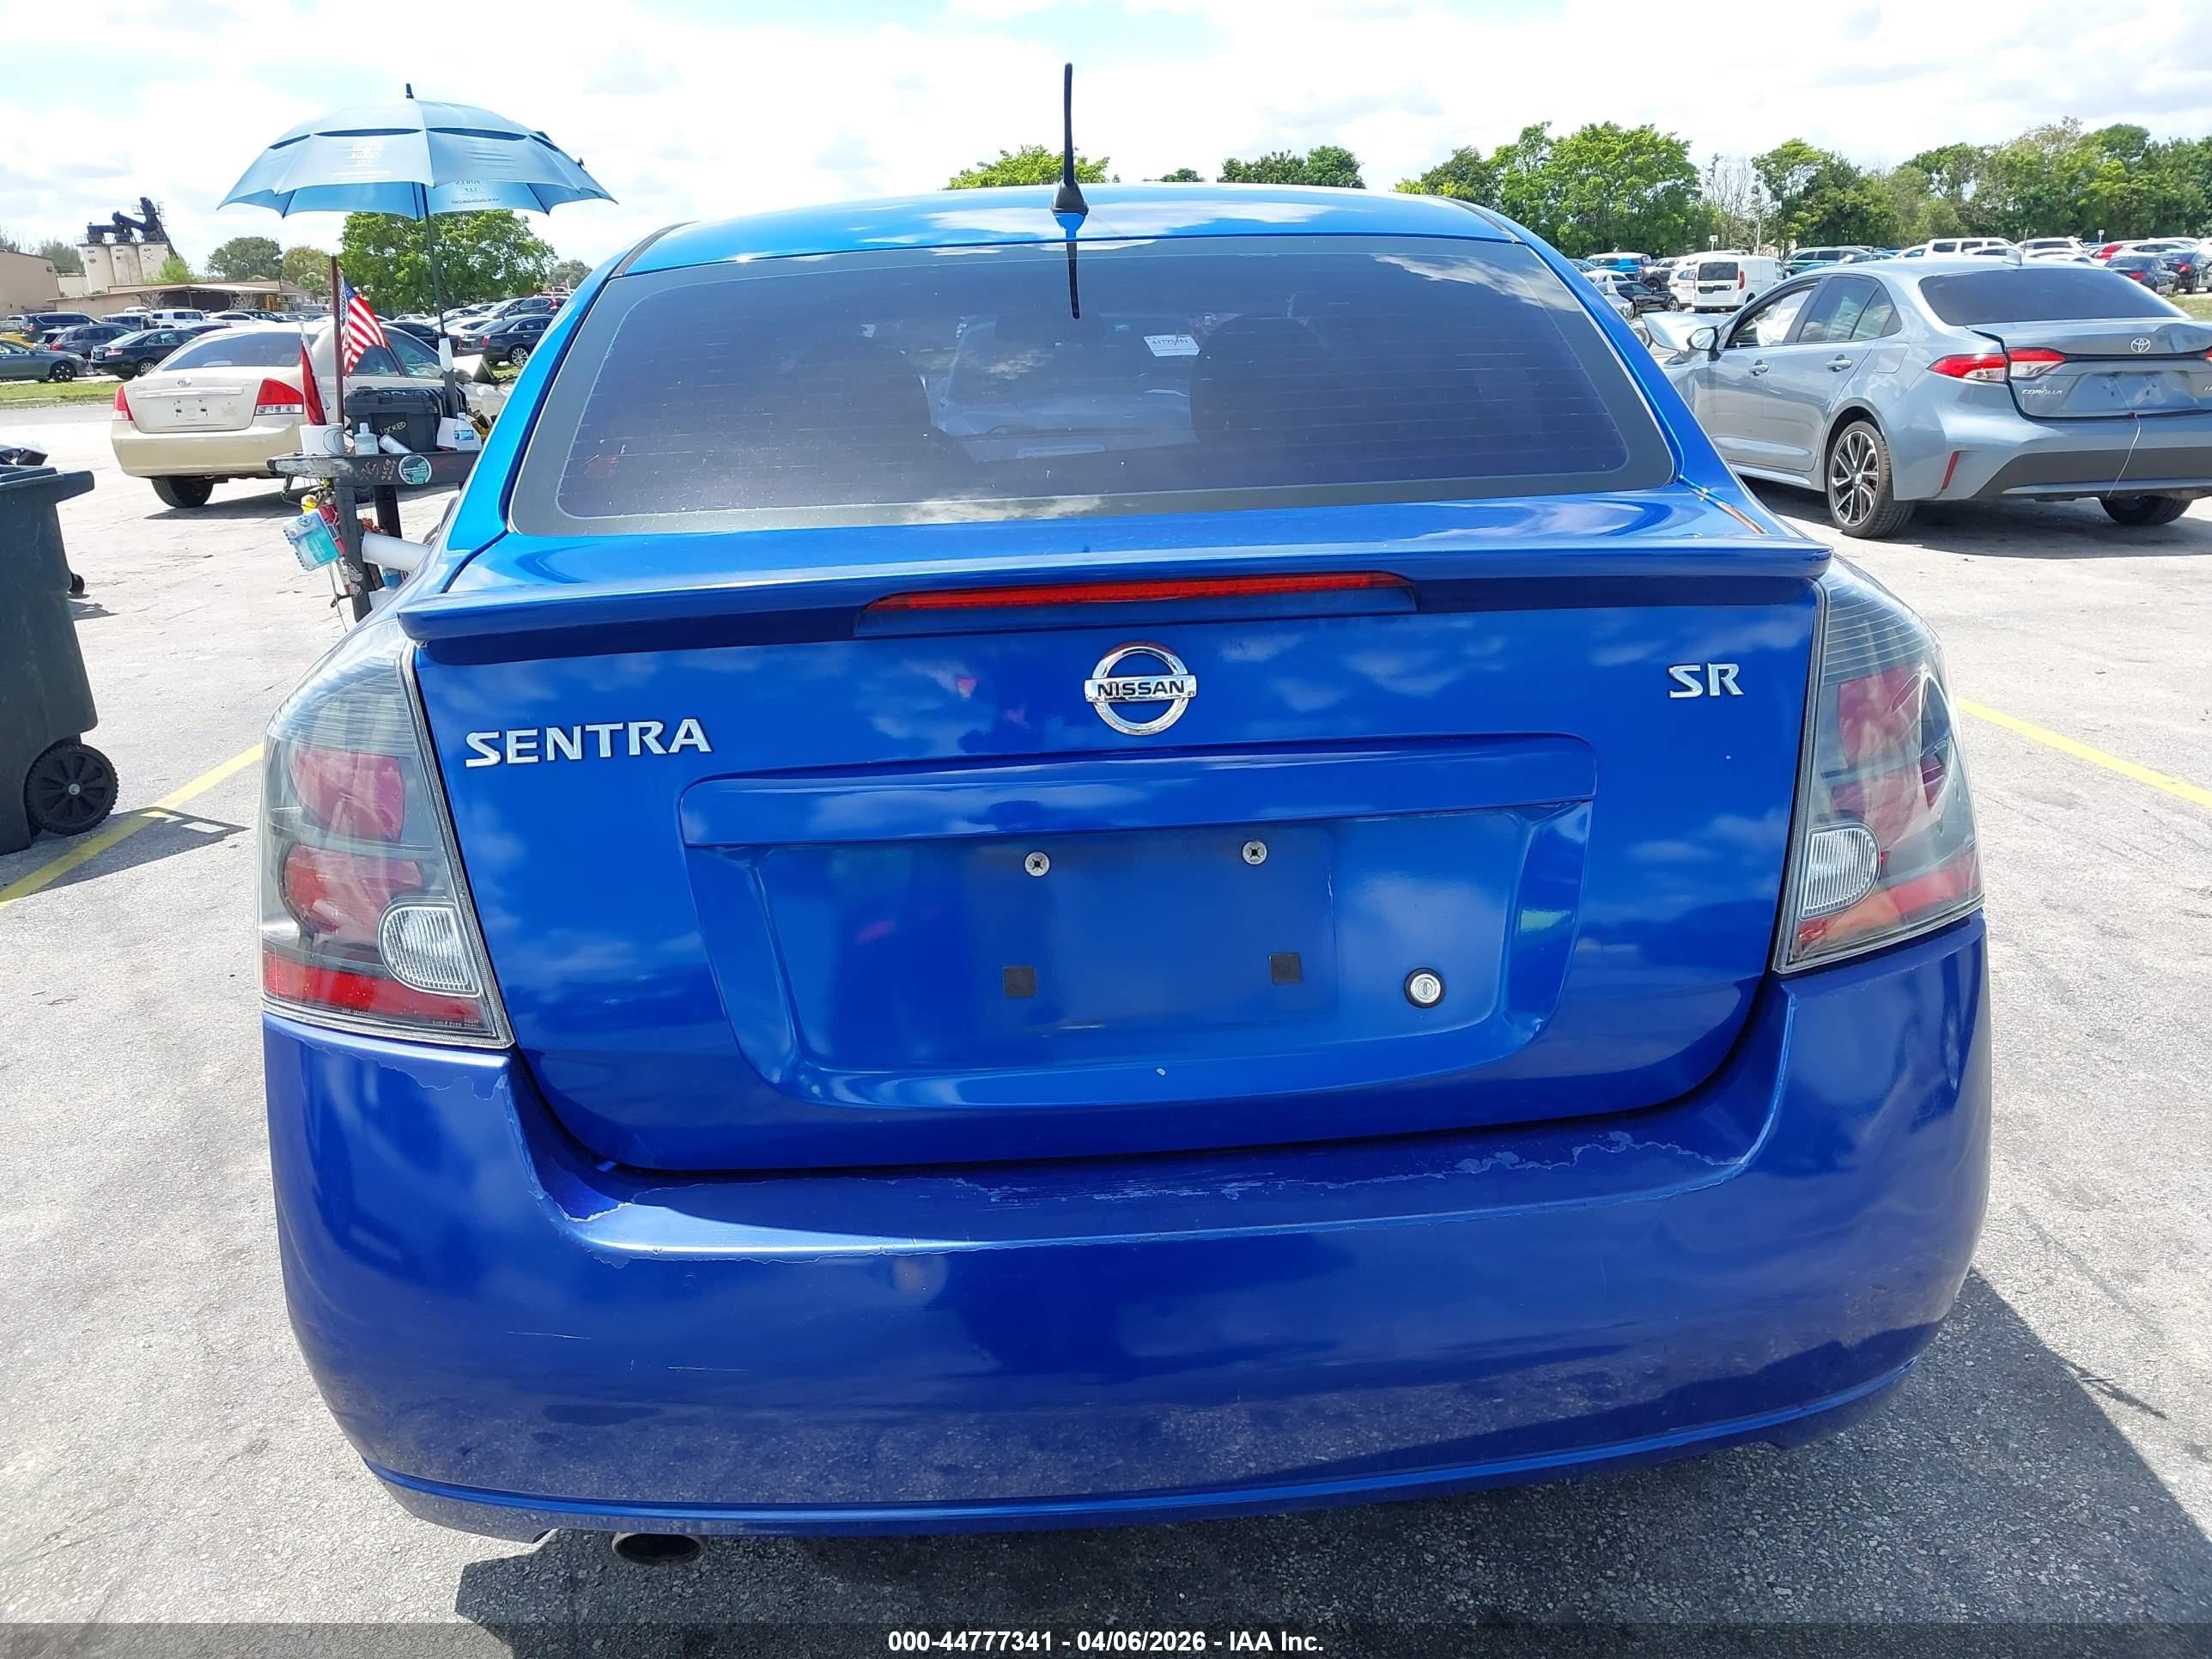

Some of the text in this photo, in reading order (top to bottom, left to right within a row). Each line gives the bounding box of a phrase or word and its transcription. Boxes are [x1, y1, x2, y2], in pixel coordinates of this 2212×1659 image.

[1097, 679, 1185, 697] NISSAN
[1668, 662, 1745, 699] SR
[465, 718, 713, 769] SENTRA
